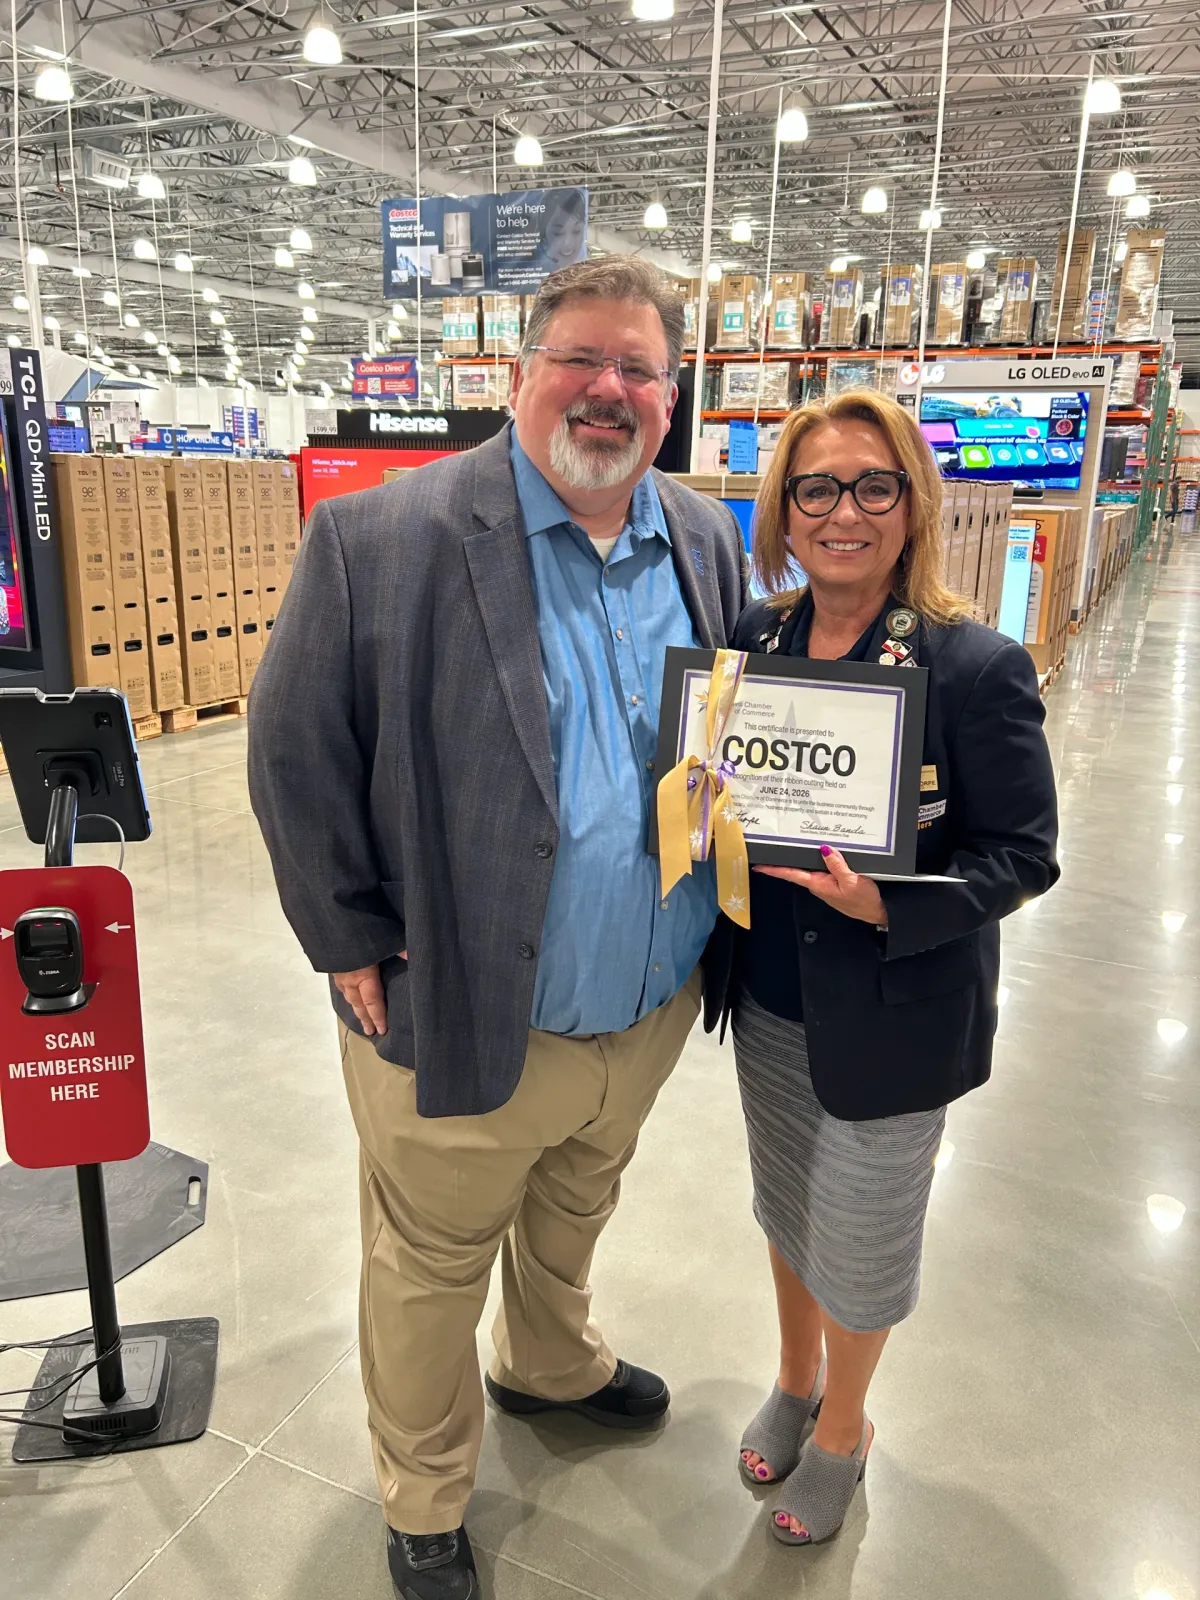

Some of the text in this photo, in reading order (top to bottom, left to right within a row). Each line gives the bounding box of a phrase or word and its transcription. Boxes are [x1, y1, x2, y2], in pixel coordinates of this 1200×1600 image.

[496, 203, 546, 215] We're here
[496, 216, 528, 228] to help
[921, 365, 946, 384] LG
[1008, 368, 1026, 380] LG
[1031, 366, 1071, 379] OLED
[1092, 366, 1105, 377] AI
[19, 356, 37, 411] TCL
[370, 412, 448, 432] Hisense
[744, 702, 772, 710] Chamber
[742, 709, 775, 718] Commerce
[140, 722, 157, 731] COSTCO
[744, 722, 757, 730] This
[758, 724, 788, 734] certificate
[796, 728, 826, 737] presented
[722, 735, 856, 776] COSTCO
[780, 789, 790, 797] 24,
[792, 789, 810, 797] 2026
[919, 803, 946, 814] Chamber
[800, 820, 830, 831] Shaun
[45, 1031, 95, 1050] SCAN
[8, 1055, 135, 1079] MEMBERSHIP
[50, 1083, 100, 1101] HERE
